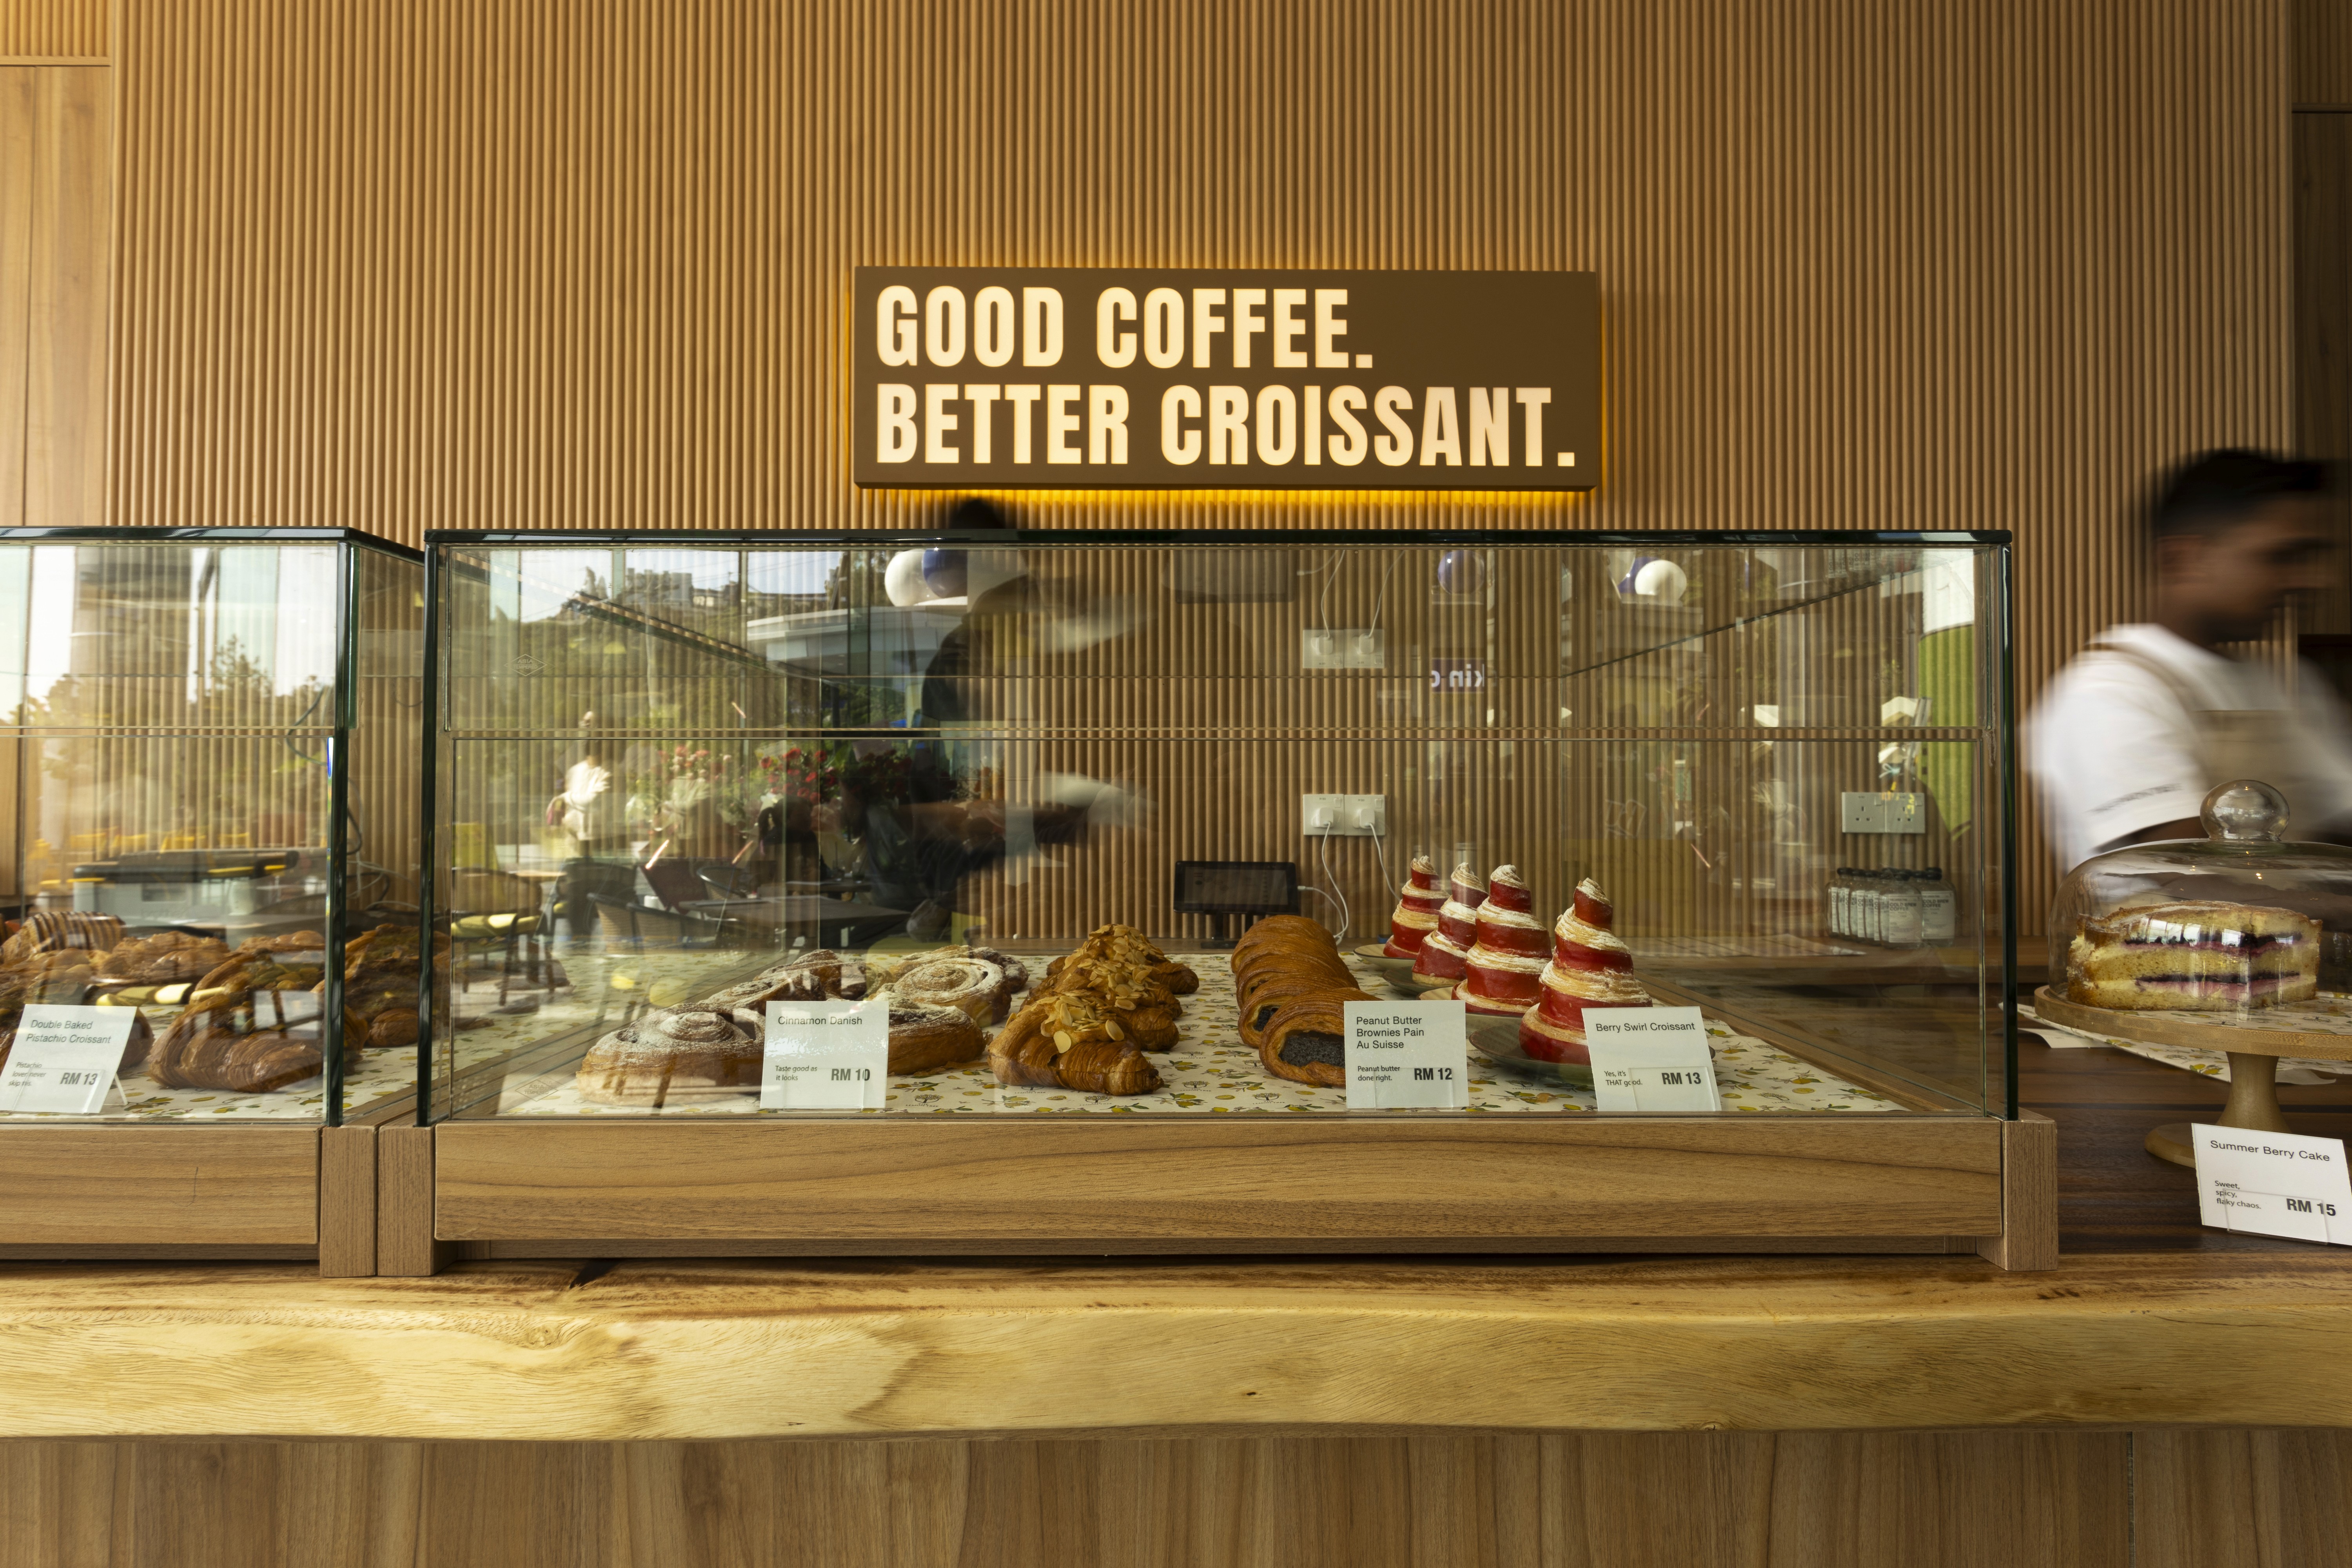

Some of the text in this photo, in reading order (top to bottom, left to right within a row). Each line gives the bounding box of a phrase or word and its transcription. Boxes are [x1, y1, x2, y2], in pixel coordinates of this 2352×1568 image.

[877, 285, 1372, 369] GOOD COFFEE.
[877, 384, 1575, 467] BETTER CROISSANT.
[30, 1020, 93, 1029] Double Baked
[778, 1016, 862, 1025] Cinnamon Danish
[1357, 1028, 1400, 1037] Brownies
[1596, 1022, 1695, 1033] Berry Swirl Croissant
[26, 1034, 112, 1044] Pistachio Croissant
[1373, 1040, 1404, 1049] Suisse
[60, 1073, 98, 1085] RM 13
[831, 1069, 870, 1081] RM 10
[1414, 1068, 1452, 1080] RM 12
[1662, 1072, 1701, 1084] RM 13
[2210, 1140, 2330, 1161] Summer Berry Cake
[2214, 1181, 2240, 1189] Sweet,
[2216, 1190, 2237, 1198] spicy,
[2216, 1198, 2261, 1209] flaky chaos.
[2286, 1198, 2336, 1216] RM 15
